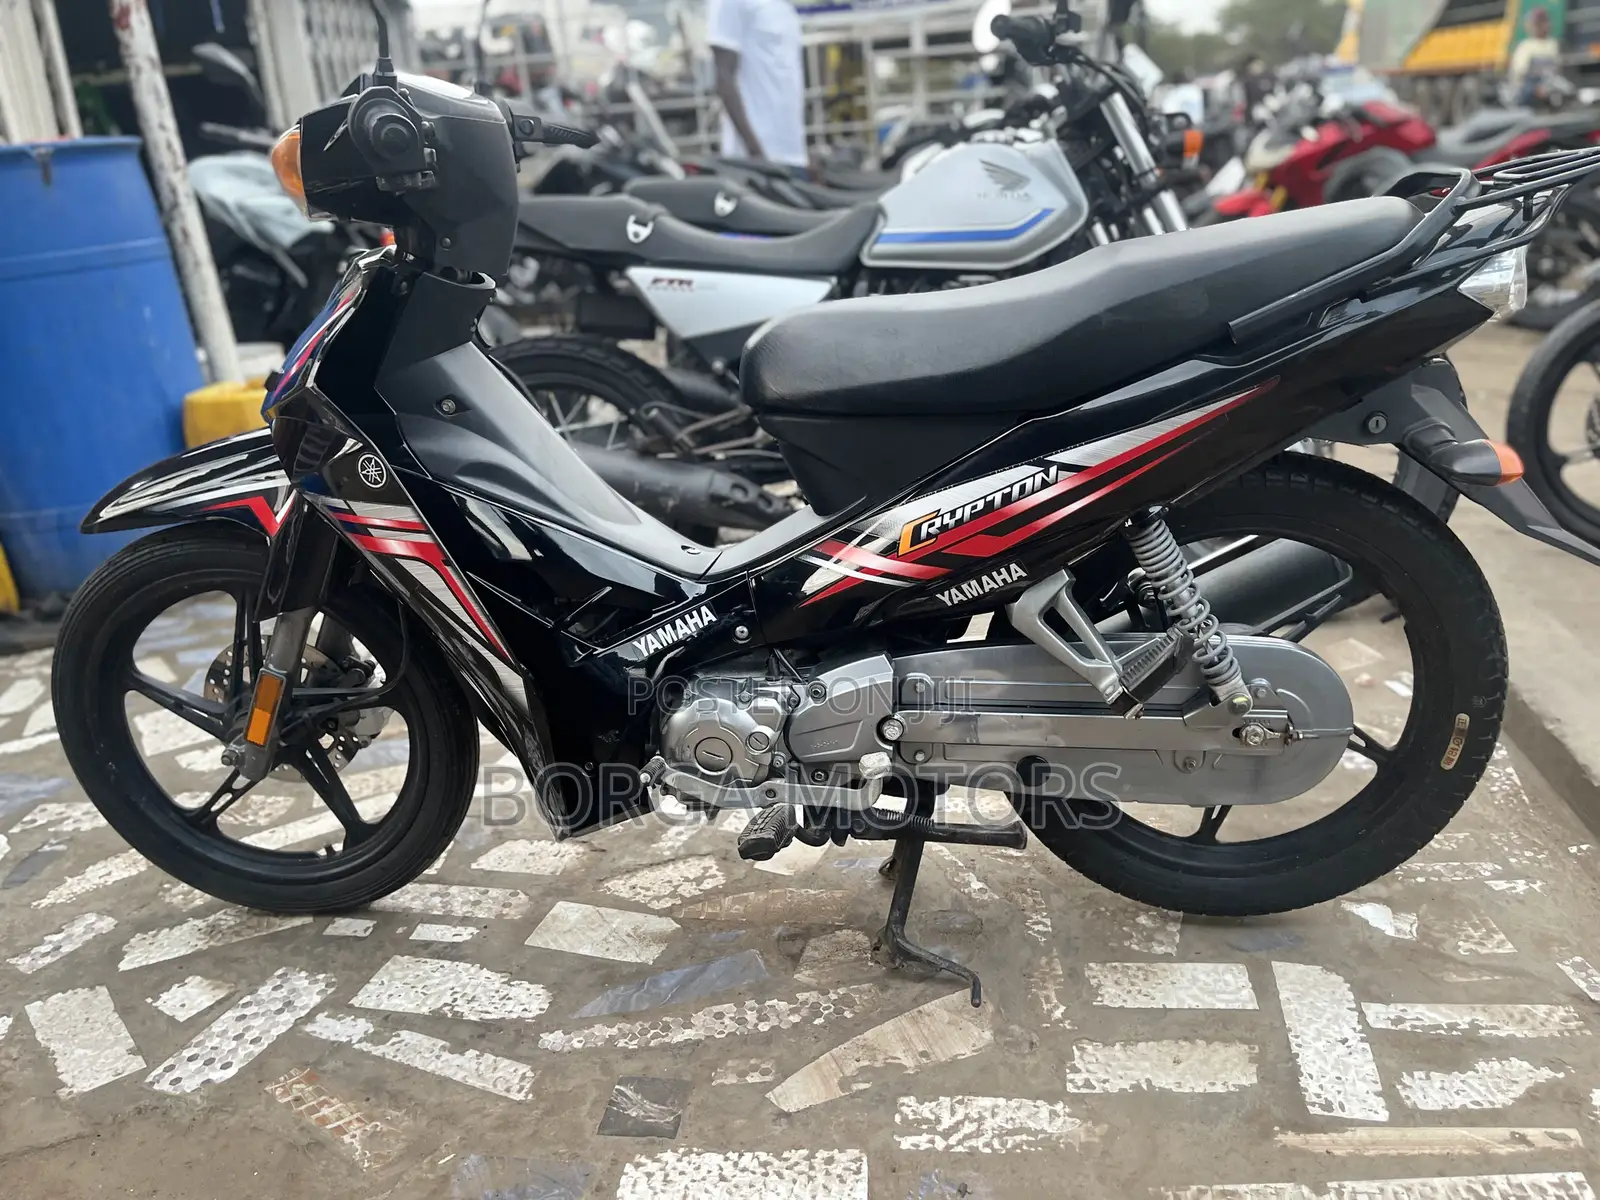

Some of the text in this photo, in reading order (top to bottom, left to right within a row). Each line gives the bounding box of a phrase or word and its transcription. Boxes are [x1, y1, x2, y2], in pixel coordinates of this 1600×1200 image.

[898, 464, 1058, 557] CRYPTON
[935, 562, 1028, 607] YAMAHA
[632, 605, 718, 657] YAMAHA
